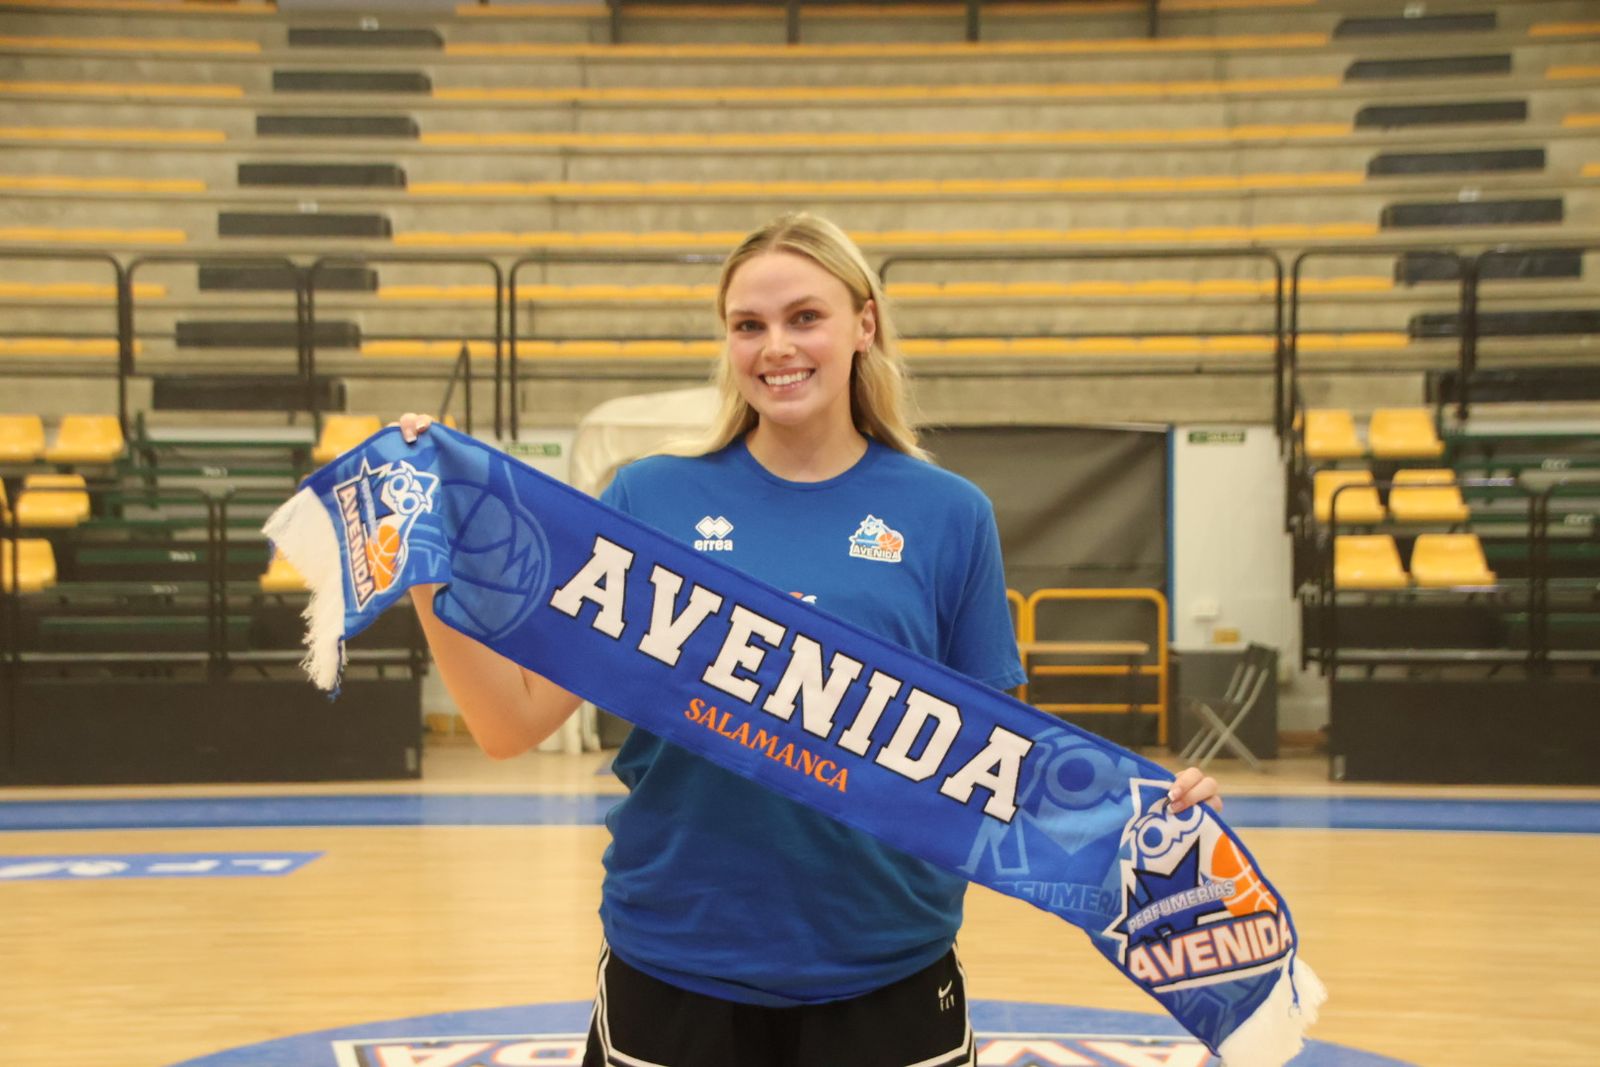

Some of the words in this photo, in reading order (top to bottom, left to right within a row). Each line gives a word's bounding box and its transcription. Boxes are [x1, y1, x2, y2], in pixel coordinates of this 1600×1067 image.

[337, 485, 376, 604] AVENIDA
[853, 544, 899, 560] AVENIDA
[549, 534, 1033, 823] AVENIDA
[684, 698, 848, 793] SALAMANCA
[1127, 880, 1236, 934] PERFUMERÍAS
[1129, 911, 1293, 983] AVENIDA
